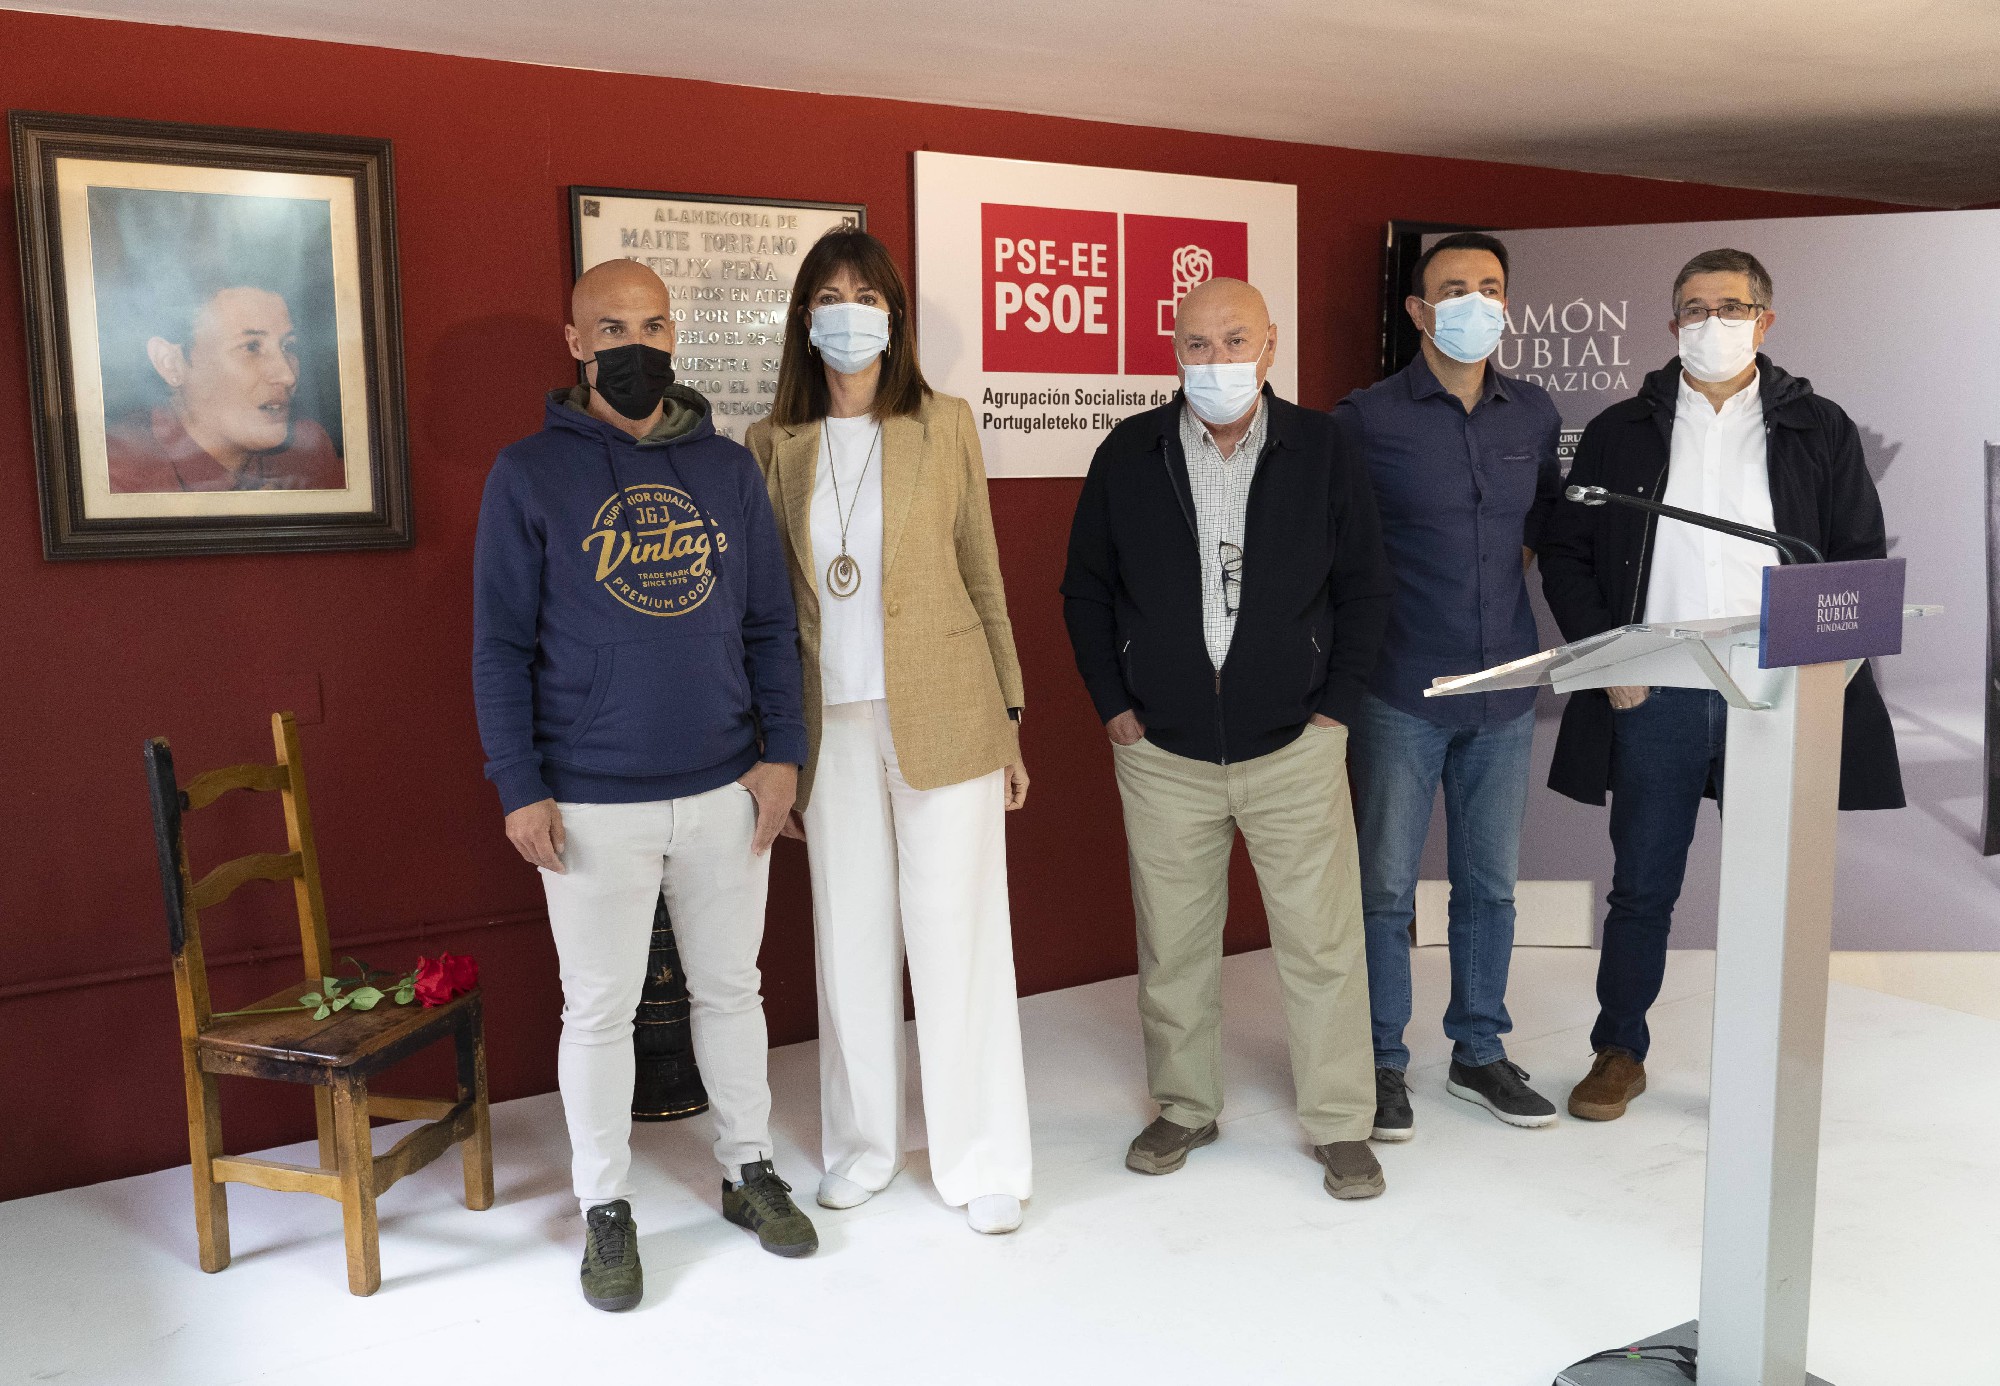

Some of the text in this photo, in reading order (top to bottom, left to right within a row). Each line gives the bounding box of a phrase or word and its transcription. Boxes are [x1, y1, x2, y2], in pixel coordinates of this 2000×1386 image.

[777, 214, 798, 230] DE
[620, 227, 798, 256] MAITE TORRANO
[995, 237, 1108, 278] PSE-EE
[722, 258, 778, 281] PEÑA
[668, 286, 724, 301] NADOS
[730, 288, 750, 302] EN
[694, 309, 729, 323] POR
[736, 310, 779, 324] ESTA
[995, 281, 1108, 335] PSOE
[1503, 297, 1628, 335] AMÓN
[677, 330, 720, 344] EBLO
[724, 331, 743, 345] EL
[1497, 335, 1630, 370] UBIAL
[670, 357, 750, 372] VUESTRA
[729, 380, 748, 393] EL
[757, 381, 777, 394] RO
[1515, 371, 1629, 392] DAZIOA
[712, 401, 773, 415] REMOS
[983, 387, 1070, 410] Agrupación
[1074, 388, 1146, 407] Socialista
[1150, 390, 1167, 406] de
[983, 413, 1126, 435] Portugaleteko Elka
[654, 492, 701, 520] QUALITY
[582, 519, 728, 582] Vintage
[638, 569, 690, 580] TRADE MARK
[642, 580, 667, 588] SINCE
[613, 568, 712, 609] PREMIUM GOODS
[1817, 590, 1860, 608] RAMÓN
[1817, 606, 1859, 623] RUBIAL
[1816, 622, 1859, 633] FUNDAZIOA
